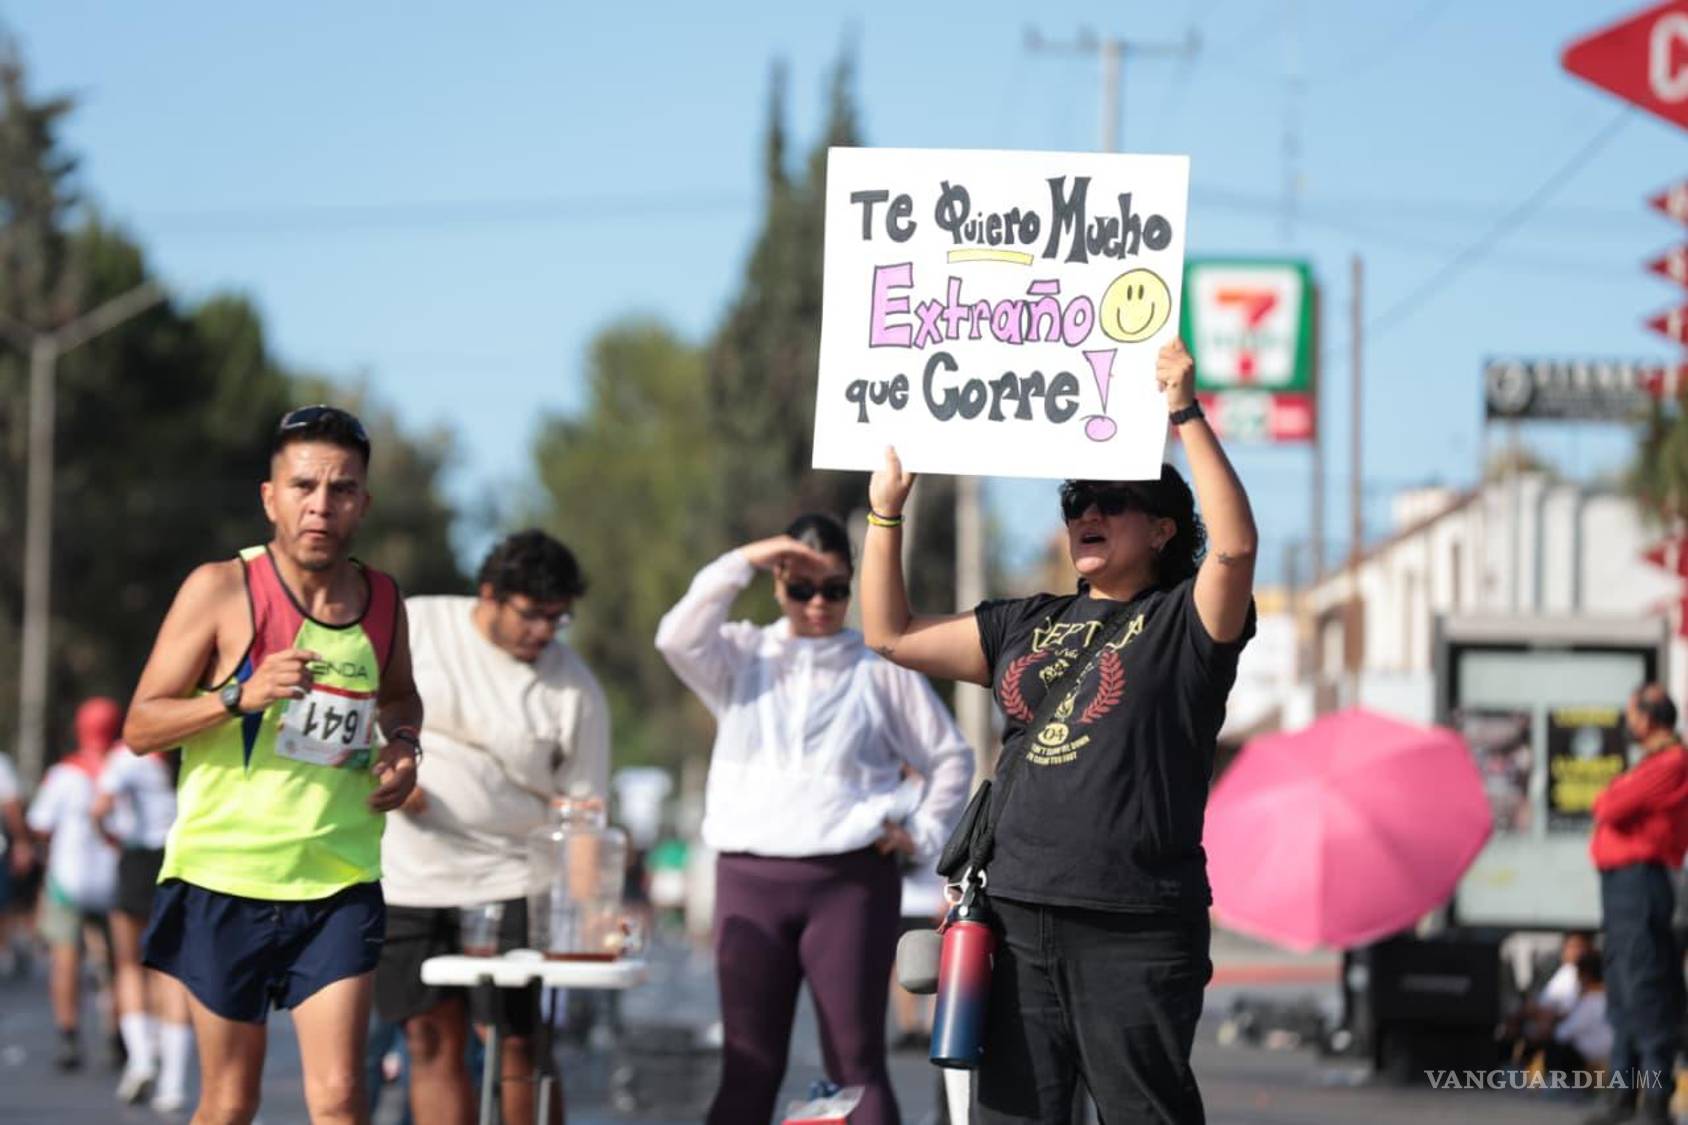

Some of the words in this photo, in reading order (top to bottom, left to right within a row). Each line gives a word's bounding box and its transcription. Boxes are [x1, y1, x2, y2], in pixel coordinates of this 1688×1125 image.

[850, 190, 917, 243] Te
[934, 180, 1041, 246] Quiero
[1041, 175, 1173, 264] Mucho
[869, 262, 1095, 349] Extraño
[845, 373, 910, 423] que
[303, 701, 360, 745] 641
